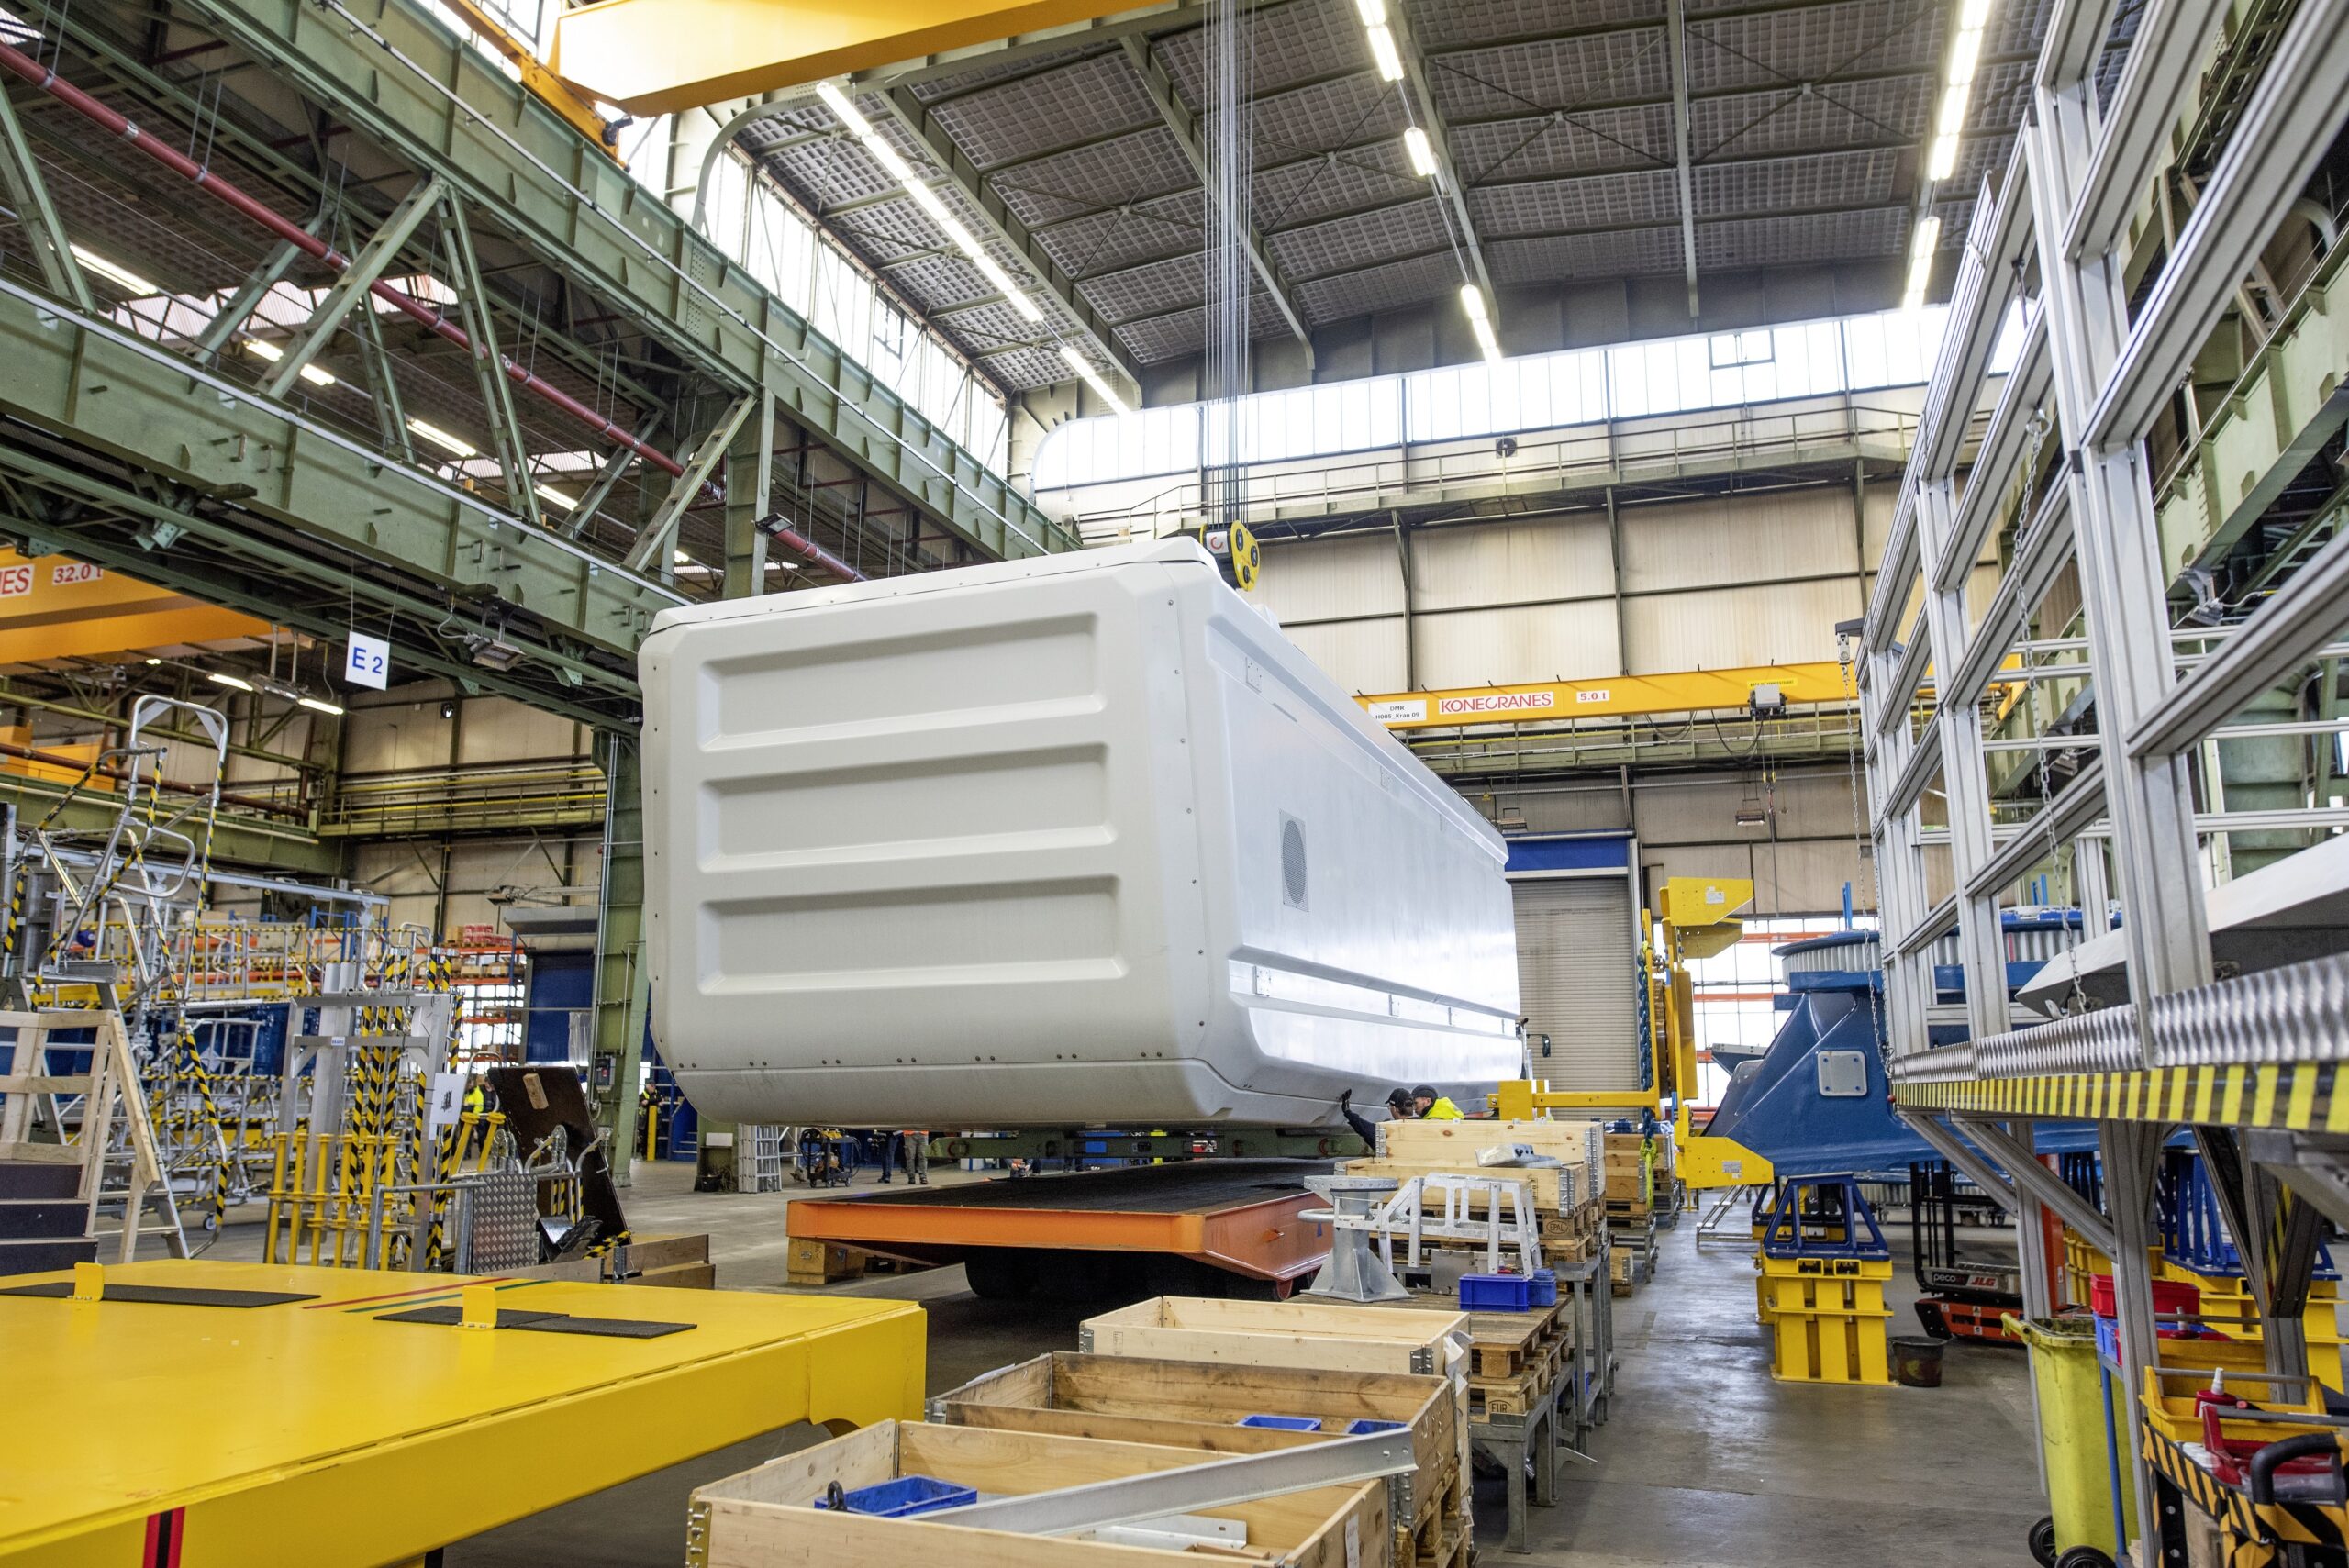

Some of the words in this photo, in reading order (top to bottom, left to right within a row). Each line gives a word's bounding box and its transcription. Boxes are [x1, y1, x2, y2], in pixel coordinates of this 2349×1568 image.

[0, 567, 30, 595] ES
[53, 563, 91, 584] 32.0
[352, 646, 367, 670] E
[372, 656, 383, 674] 2
[1441, 693, 1552, 713] KONECRANES
[1580, 692, 1598, 701] 5.0
[1971, 1276, 1997, 1286] JLG
